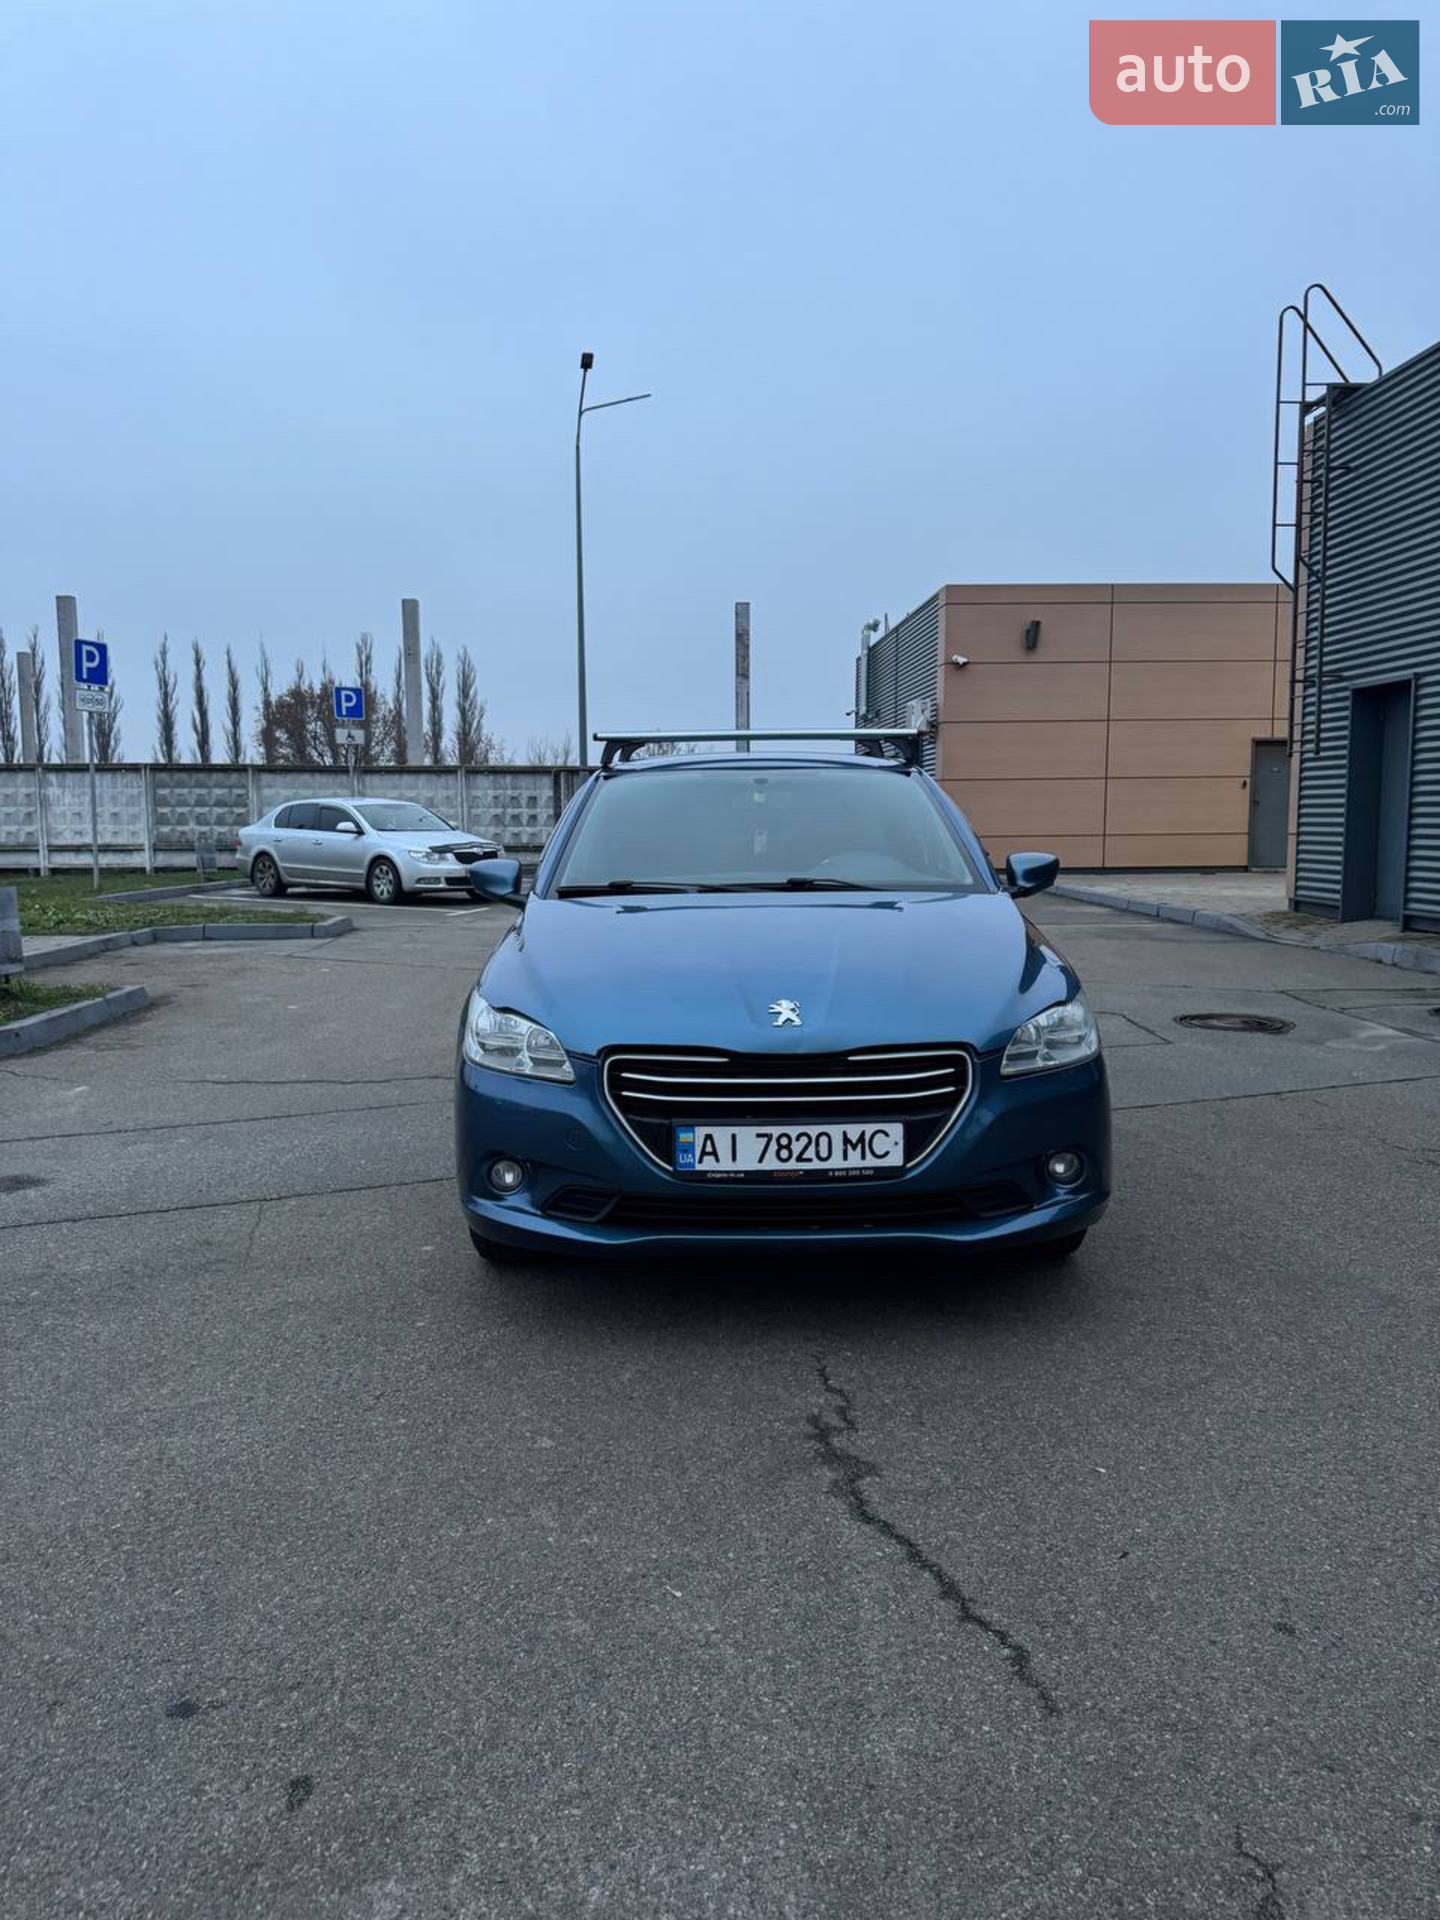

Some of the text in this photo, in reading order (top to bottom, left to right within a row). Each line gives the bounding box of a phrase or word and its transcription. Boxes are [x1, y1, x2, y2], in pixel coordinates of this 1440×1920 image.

[81, 643, 100, 680] P
[340, 690, 357, 716] P
[679, 1152, 694, 1164] UA
[697, 1129, 891, 1165] AI 7820 MC
